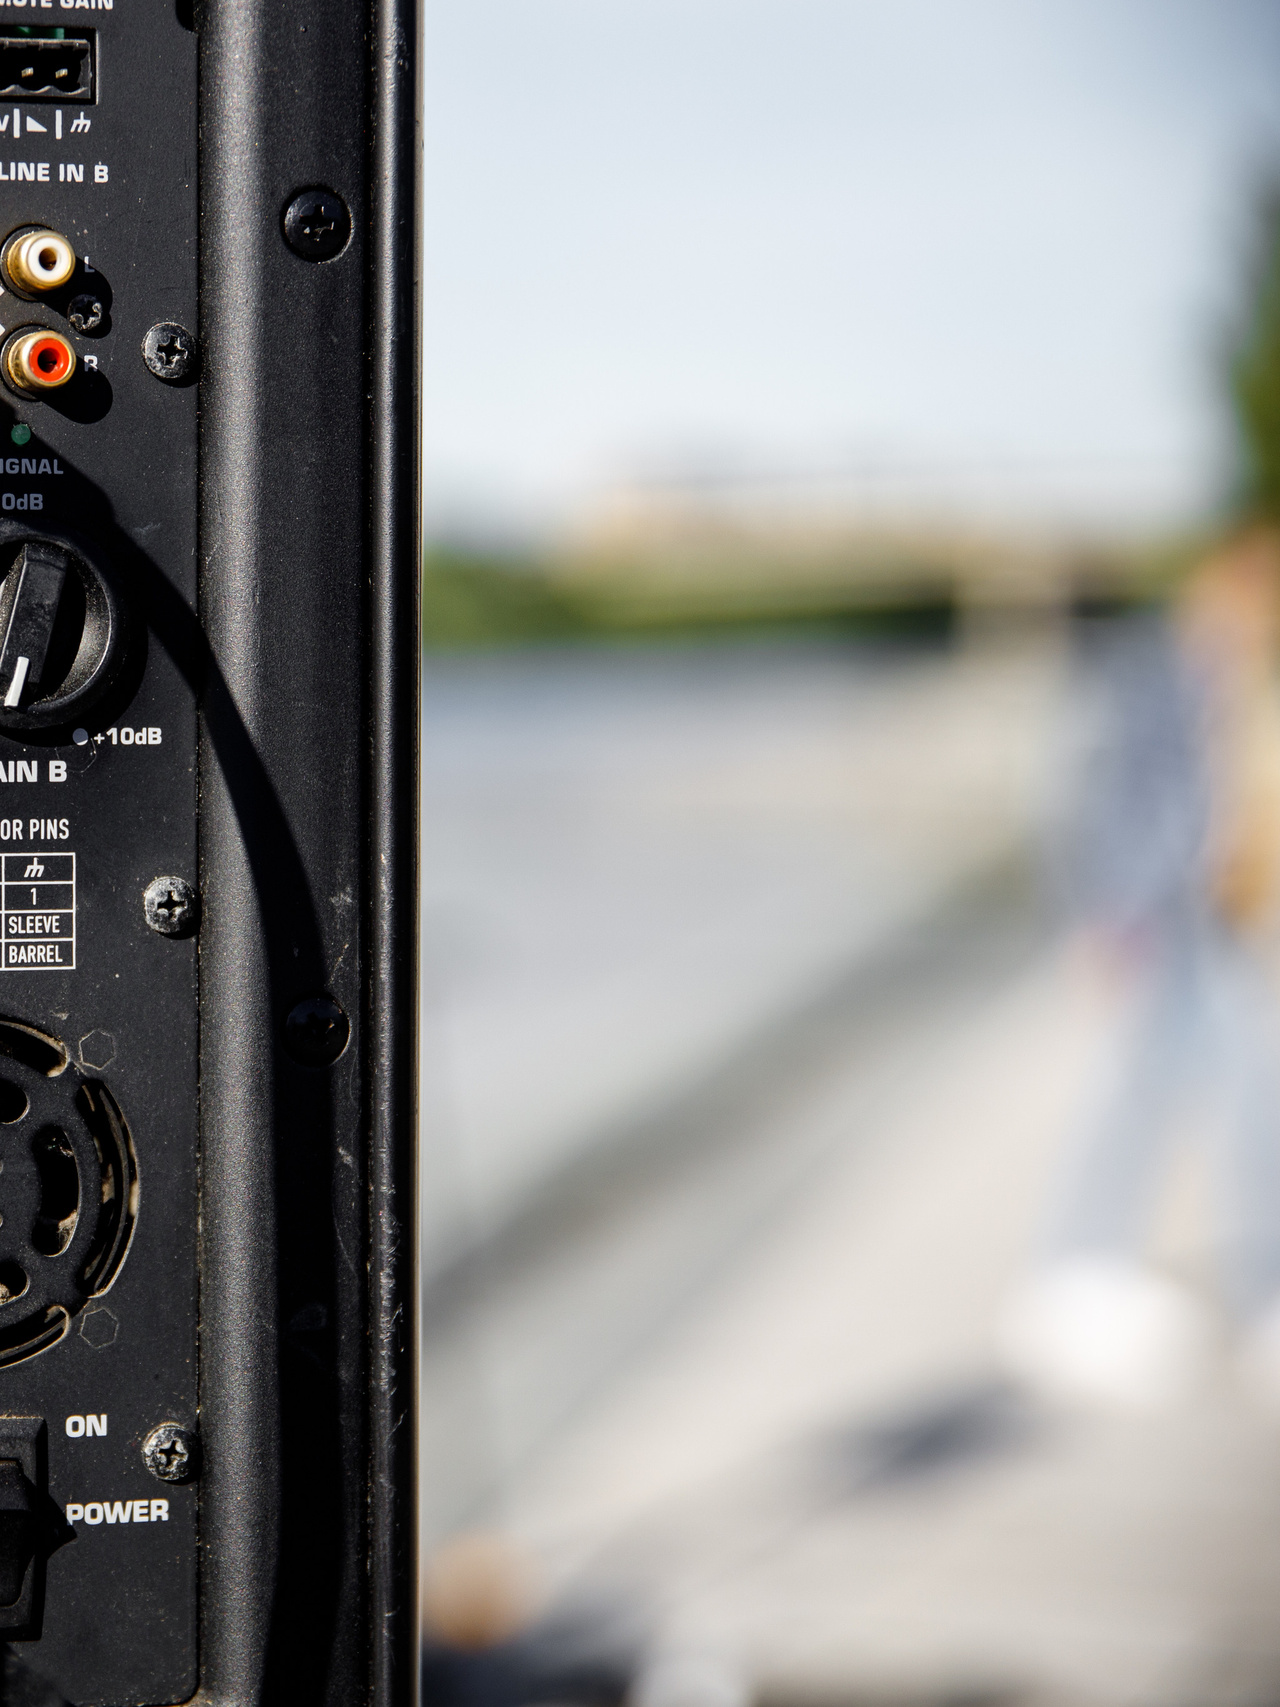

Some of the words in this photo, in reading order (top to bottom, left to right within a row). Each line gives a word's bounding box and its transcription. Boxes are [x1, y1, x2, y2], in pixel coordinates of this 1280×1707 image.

[59, 164, 84, 182] IN
[94, 163, 109, 183] B
[84, 256, 95, 273] L
[2, 493, 44, 511] 0dB
[93, 727, 162, 745] +10dB
[48, 760, 67, 782] B
[29, 818, 69, 840] PINS
[30, 887, 37, 905] 1
[8, 915, 60, 934] SLEEVE
[8, 945, 63, 964] BARREL
[65, 1414, 107, 1437] ON
[66, 1500, 169, 1525] POWER
